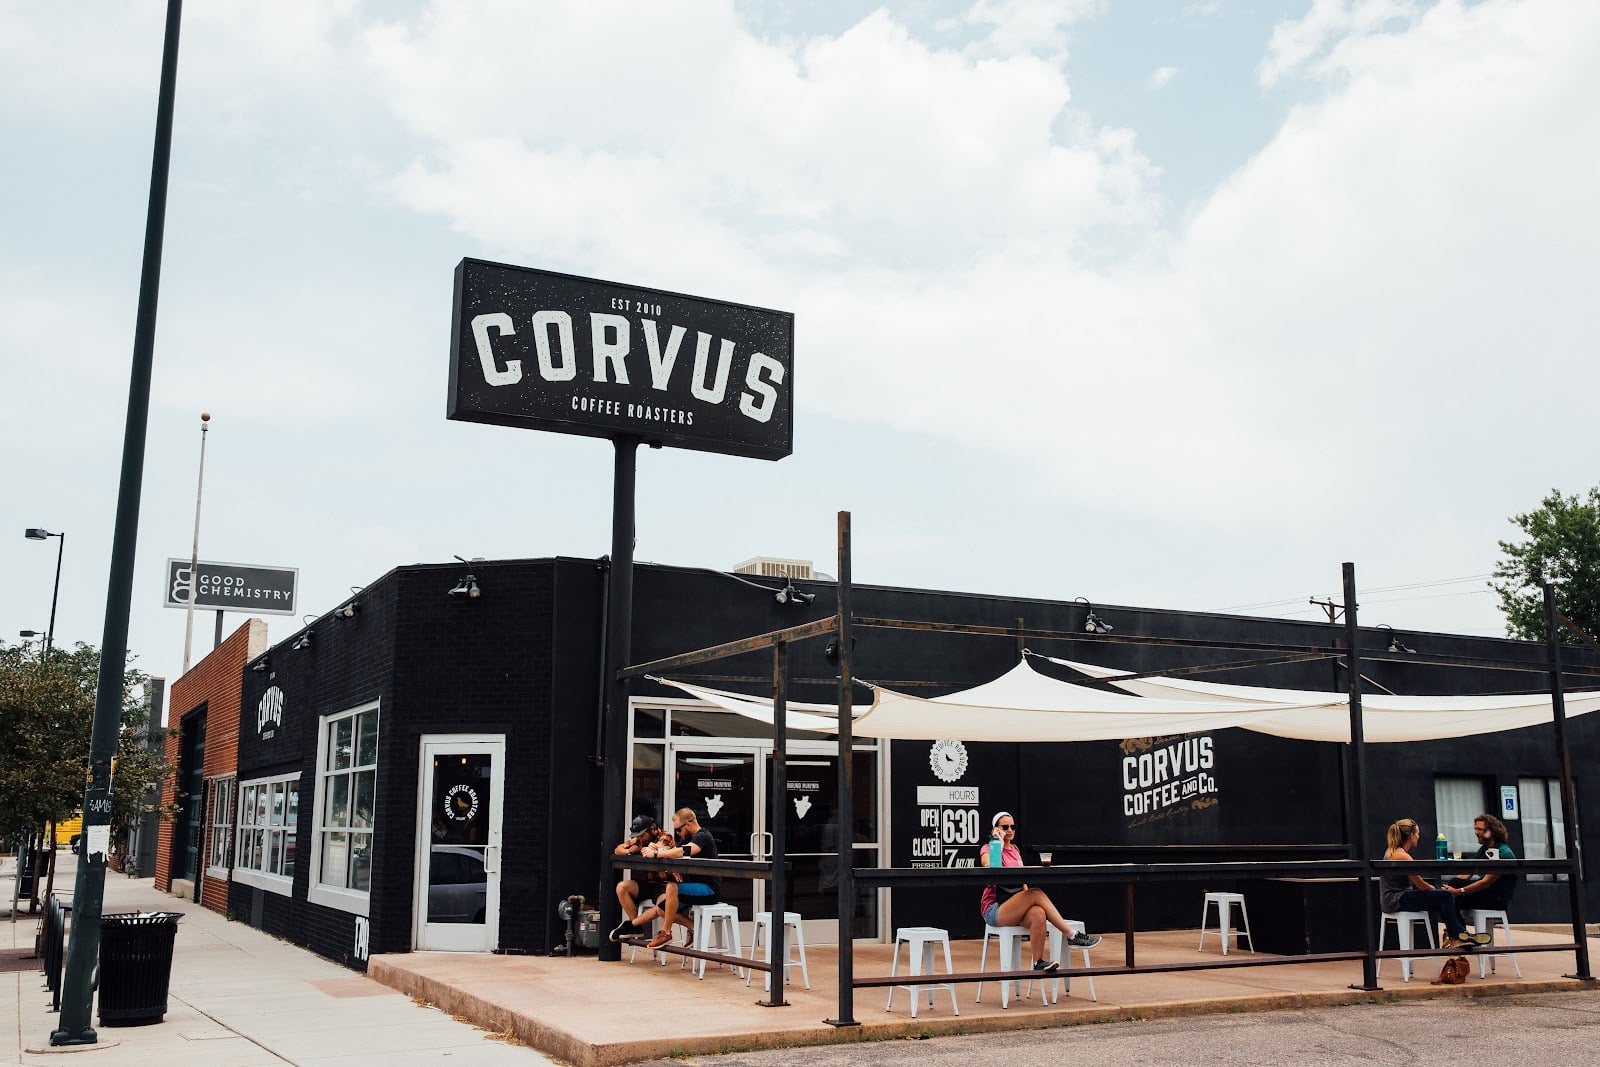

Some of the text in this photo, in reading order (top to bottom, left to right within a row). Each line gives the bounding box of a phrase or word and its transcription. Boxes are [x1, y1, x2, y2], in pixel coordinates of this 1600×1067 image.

[611, 298, 661, 316] EST 2010
[470, 310, 785, 423] CORVUS
[571, 396, 693, 425] COFFEE ROASTERS
[200, 575, 245, 587] GOOD
[199, 585, 291, 600] CHEMISTRY
[1122, 737, 1213, 790] CORVUS
[949, 790, 976, 801] HOURS
[1123, 780, 1180, 816] COFFEE
[1181, 780, 1198, 796] AND
[920, 808, 940, 827] OPEN
[942, 808, 980, 844] 630
[912, 838, 941, 857] CLOSED
[944, 848, 959, 868] 7
